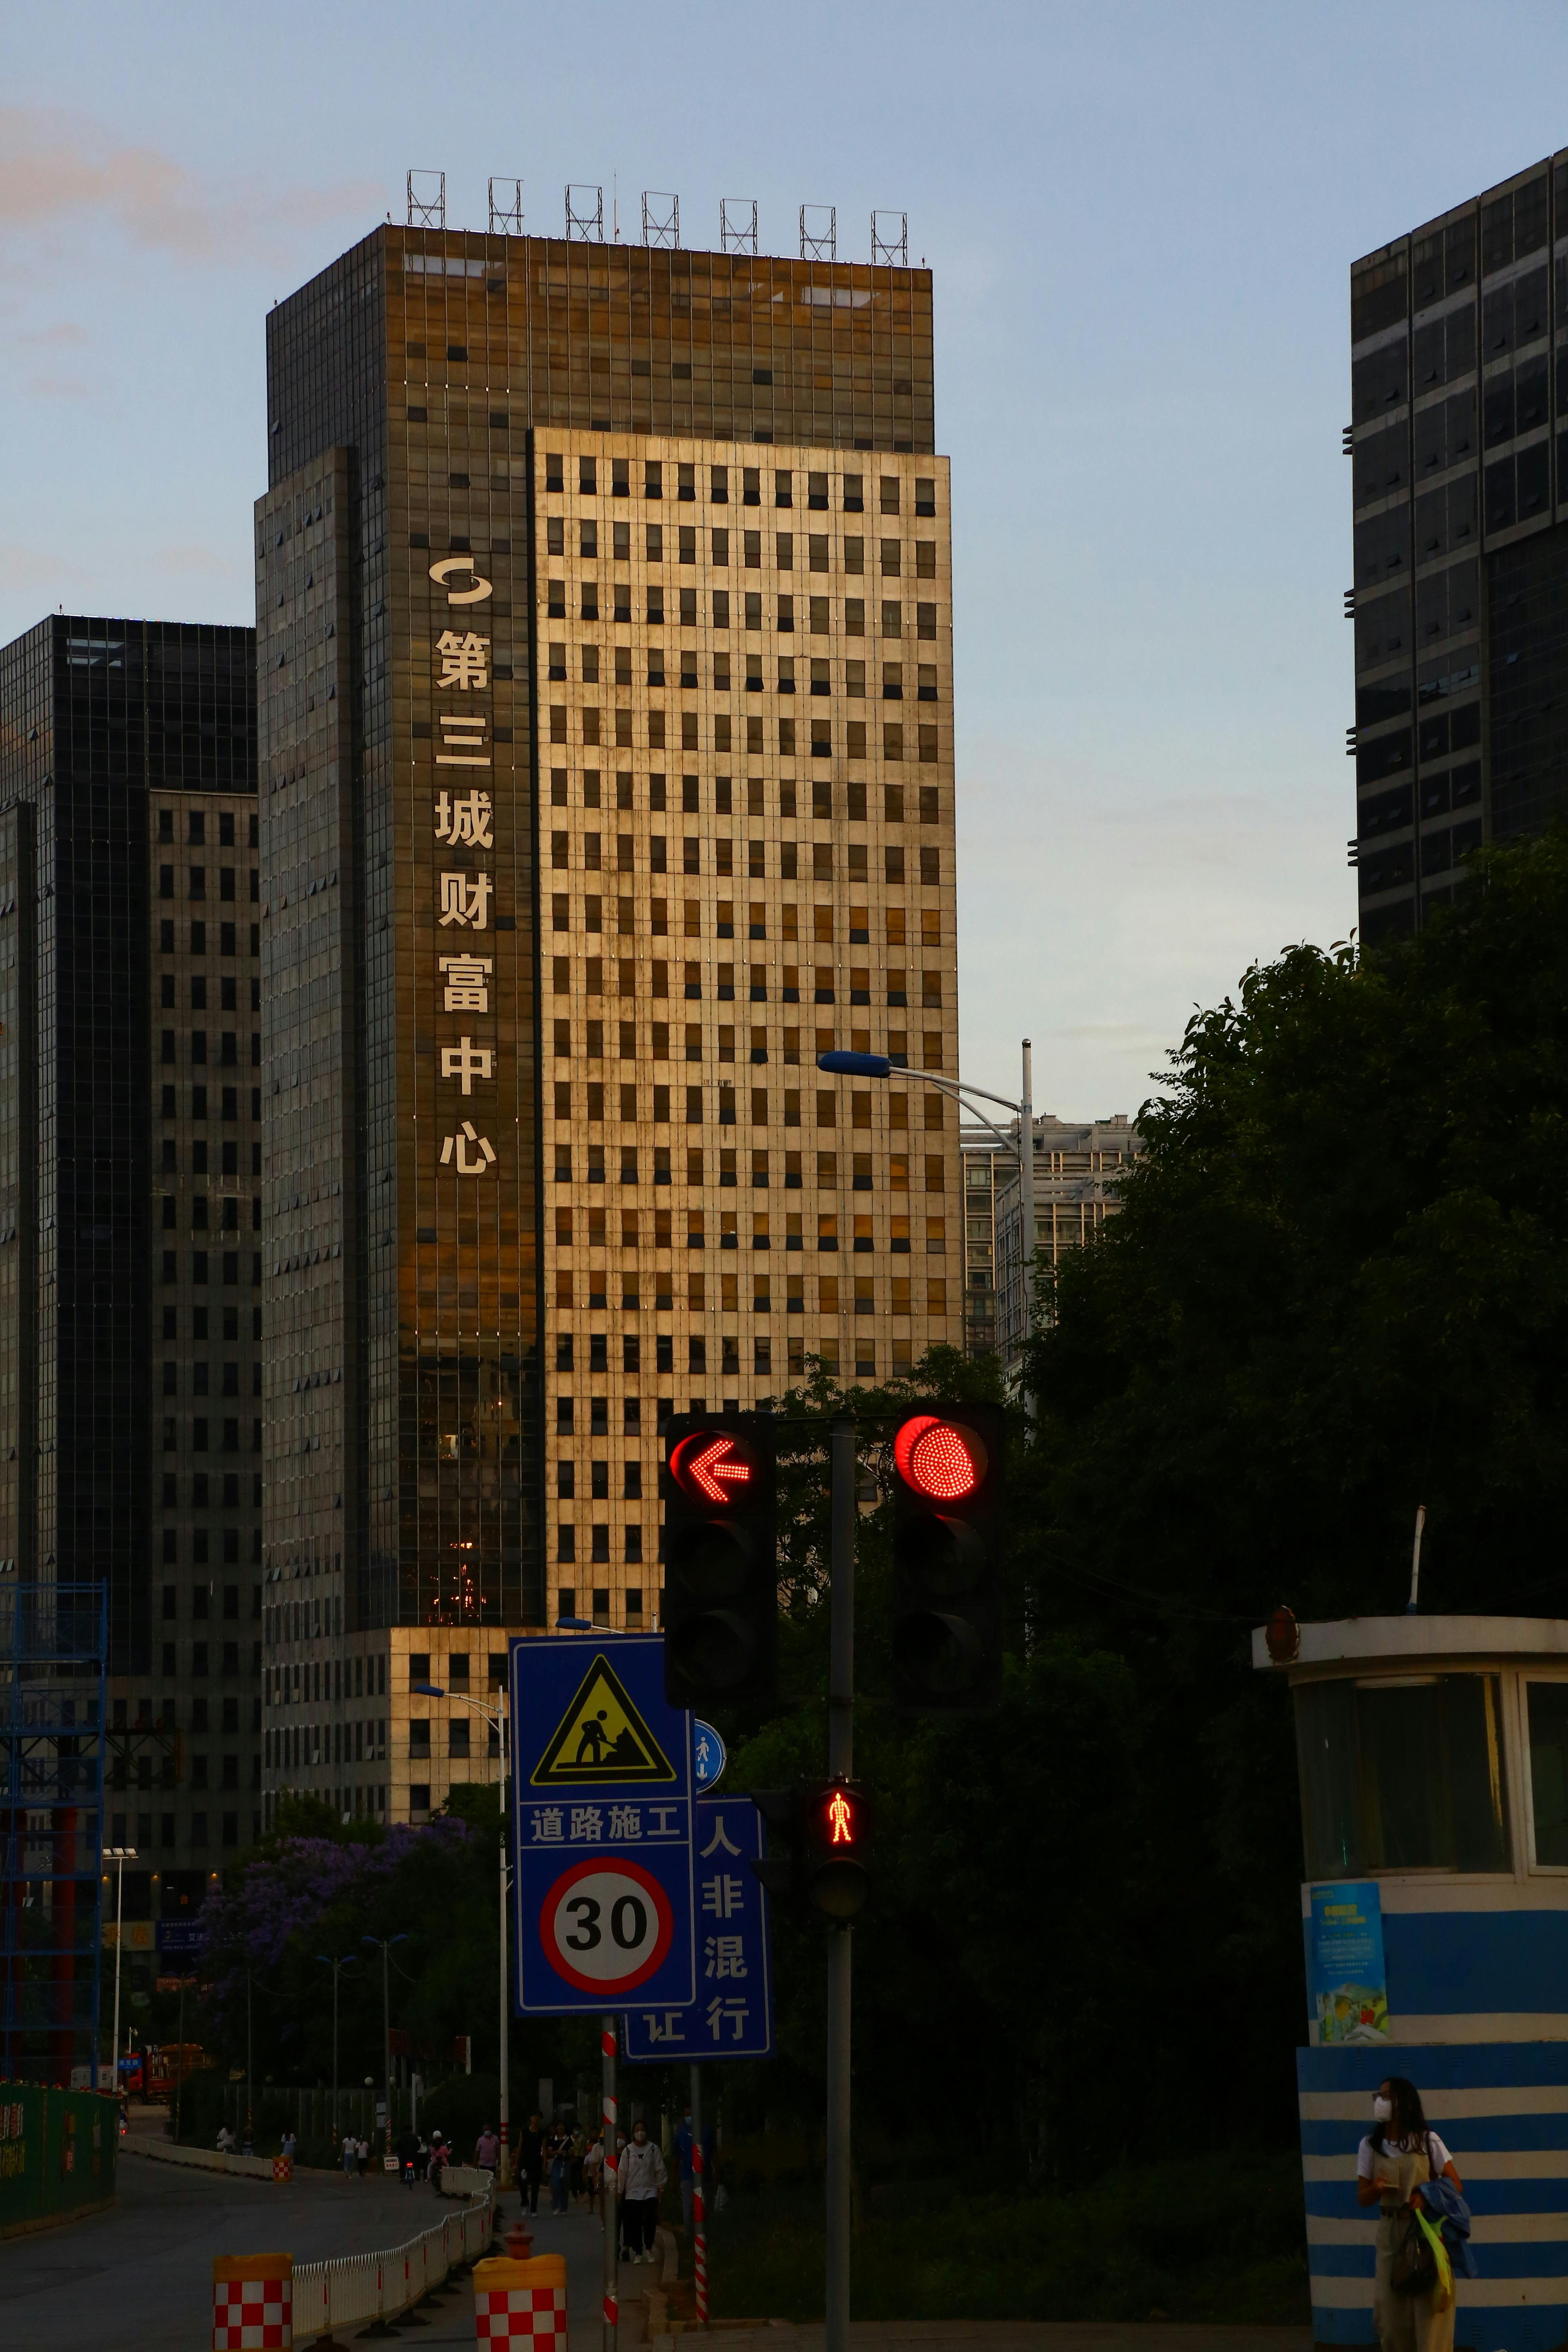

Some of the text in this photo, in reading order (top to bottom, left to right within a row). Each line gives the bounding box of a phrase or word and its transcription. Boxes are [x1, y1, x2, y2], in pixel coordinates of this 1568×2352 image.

[434, 630, 497, 1176] 第三城财富中心
[530, 1805, 680, 1842] 道路施工
[565, 1895, 648, 1951] 30
[699, 1816, 749, 2041] 人非混行
